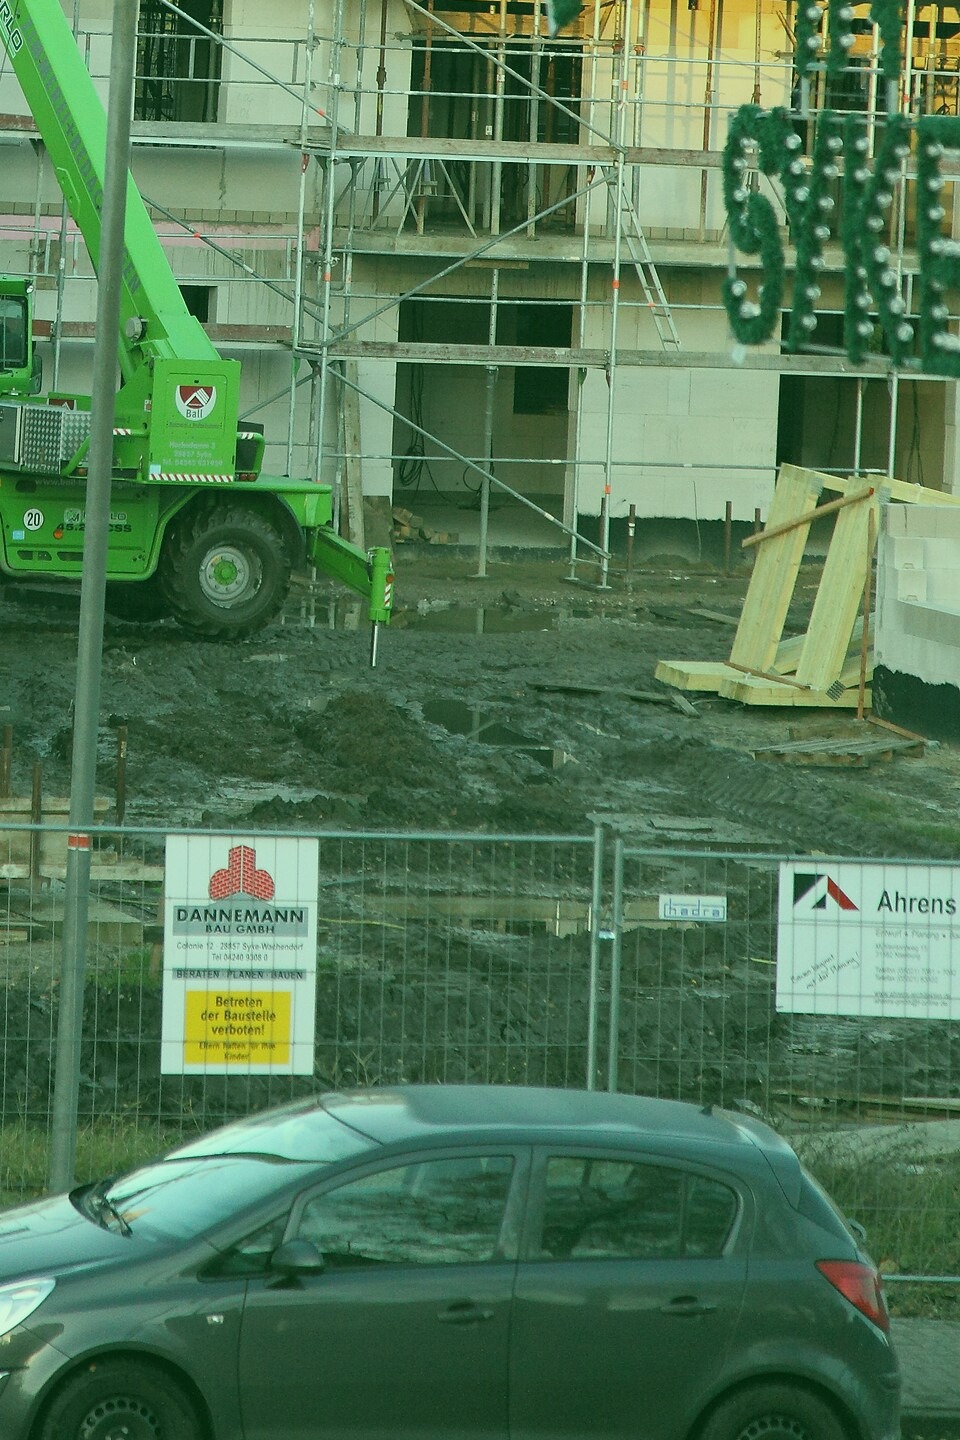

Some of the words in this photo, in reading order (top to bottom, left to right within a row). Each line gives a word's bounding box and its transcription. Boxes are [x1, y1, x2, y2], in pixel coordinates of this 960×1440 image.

[186, 409, 203, 418] Ball
[27, 512, 40, 527] 20
[669, 898, 720, 917] hadra
[877, 889, 957, 915] Ahrens
[177, 908, 304, 923] DANNEMANN
[205, 924, 232, 934] BAU
[236, 924, 275, 934] GMBH
[177, 969, 220, 979] BERATEN
[226, 969, 264, 979] PLANEN
[271, 970, 304, 980] BAUEN
[215, 996, 263, 1008] Betreten
[201, 1010, 220, 1022] der
[224, 1010, 277, 1022] Baustelle
[211, 1024, 265, 1036] verboten!
